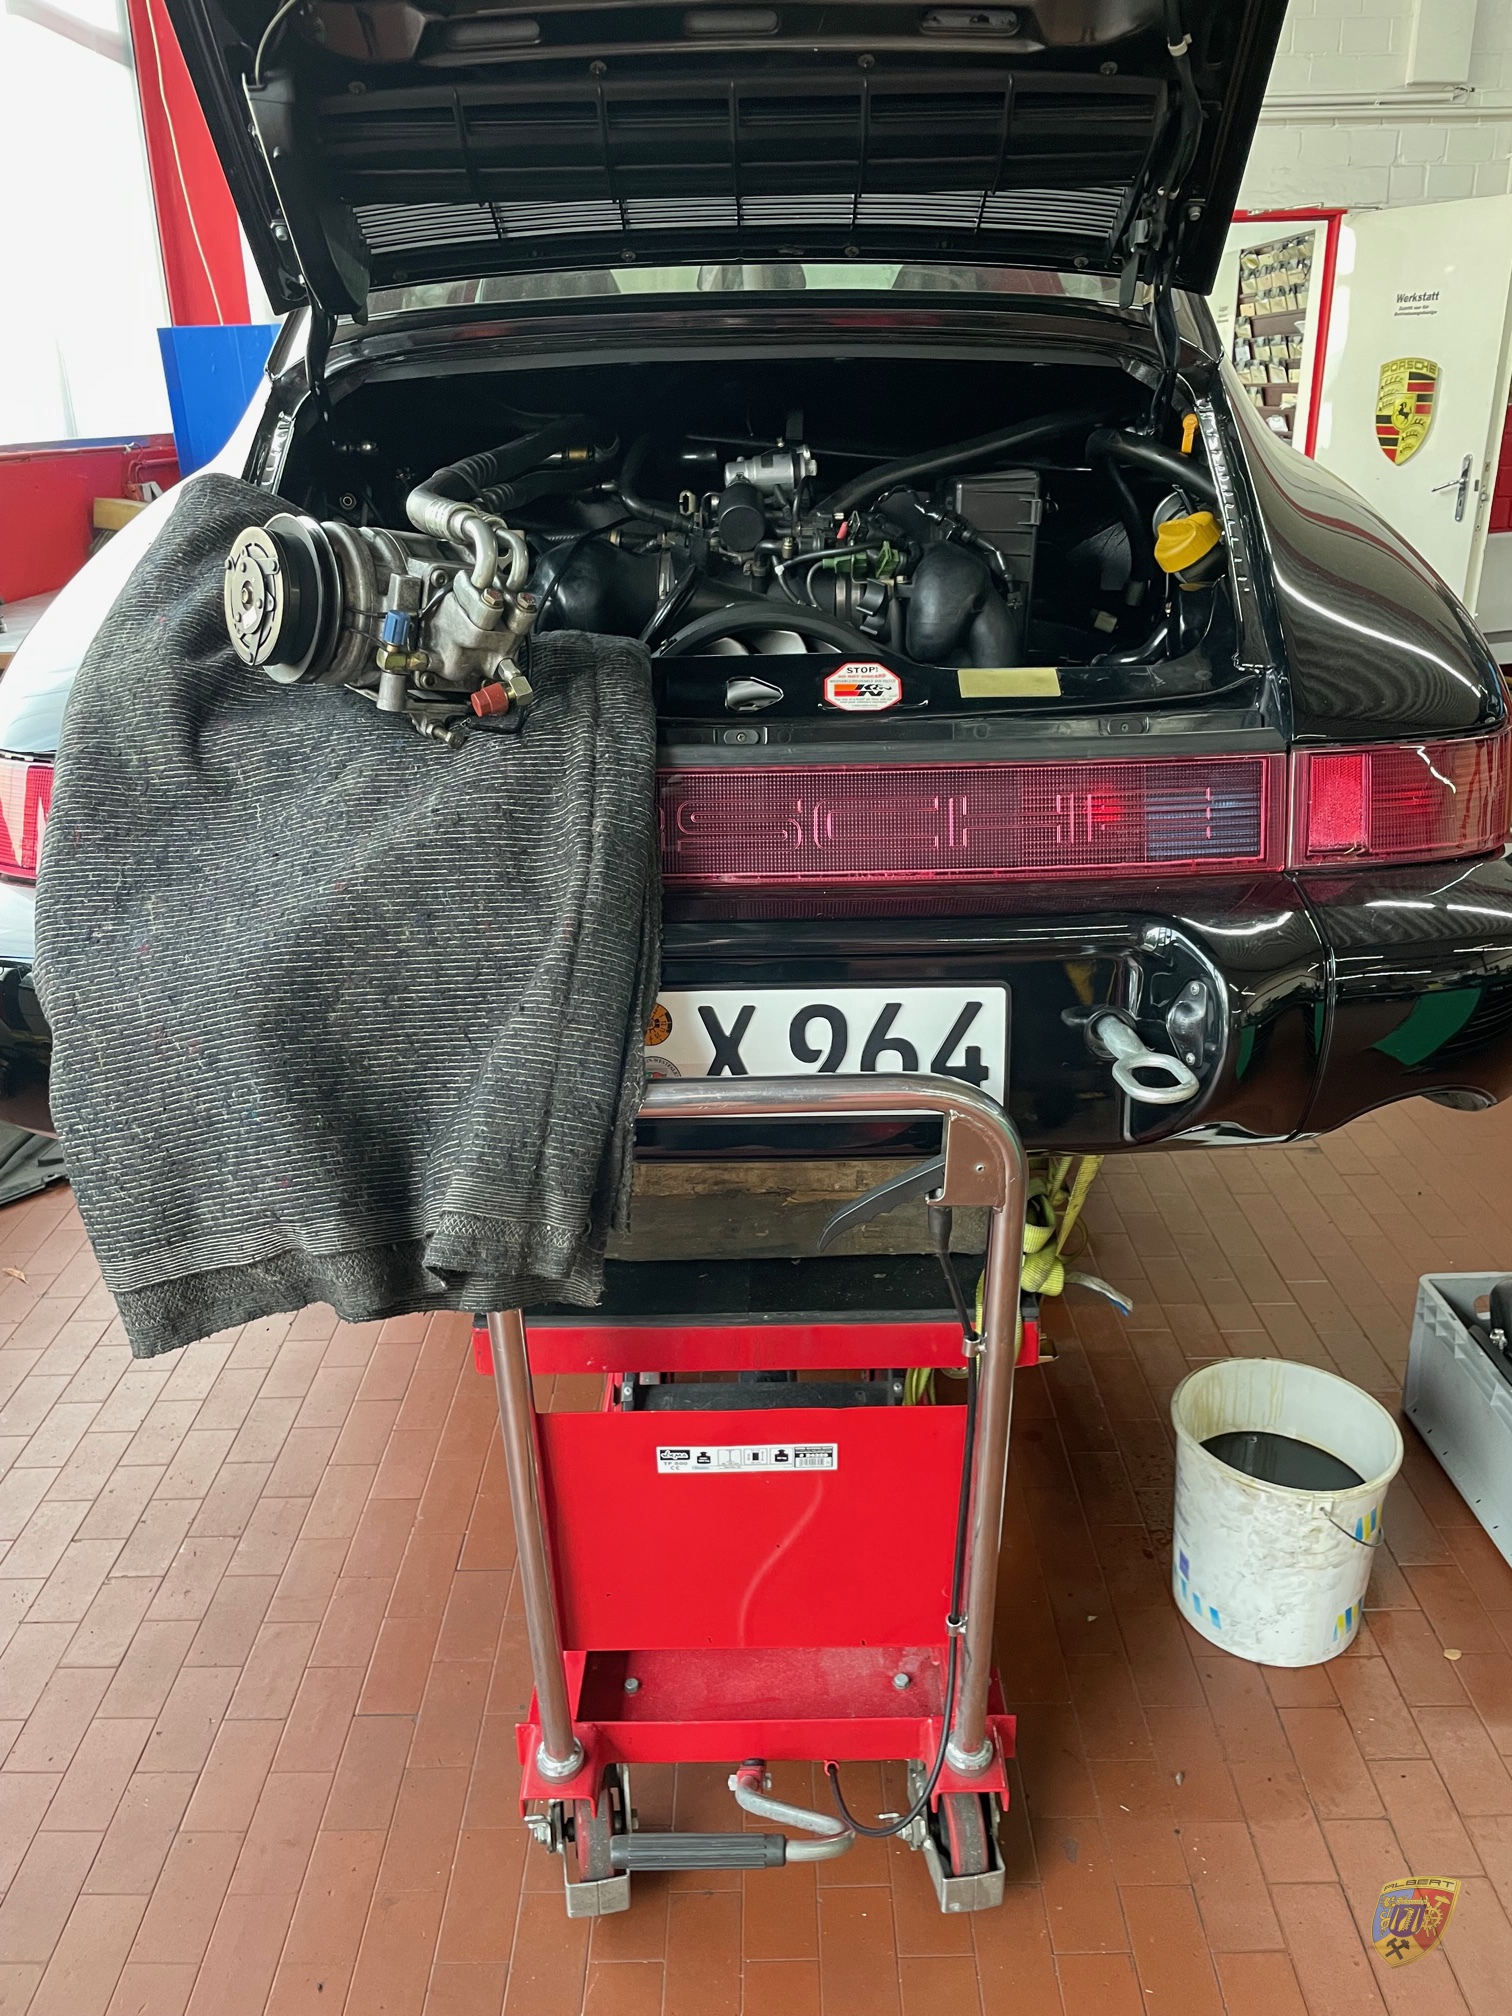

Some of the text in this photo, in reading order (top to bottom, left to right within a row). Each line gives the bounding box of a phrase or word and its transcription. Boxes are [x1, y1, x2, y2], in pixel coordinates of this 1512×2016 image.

[1396, 291, 1440, 303] Werkstatt
[1381, 360, 1437, 376] PORSCHE
[846, 666, 879, 674] STOP!
[656, 787, 1211, 853] SCHE
[698, 1001, 989, 1087] X 964
